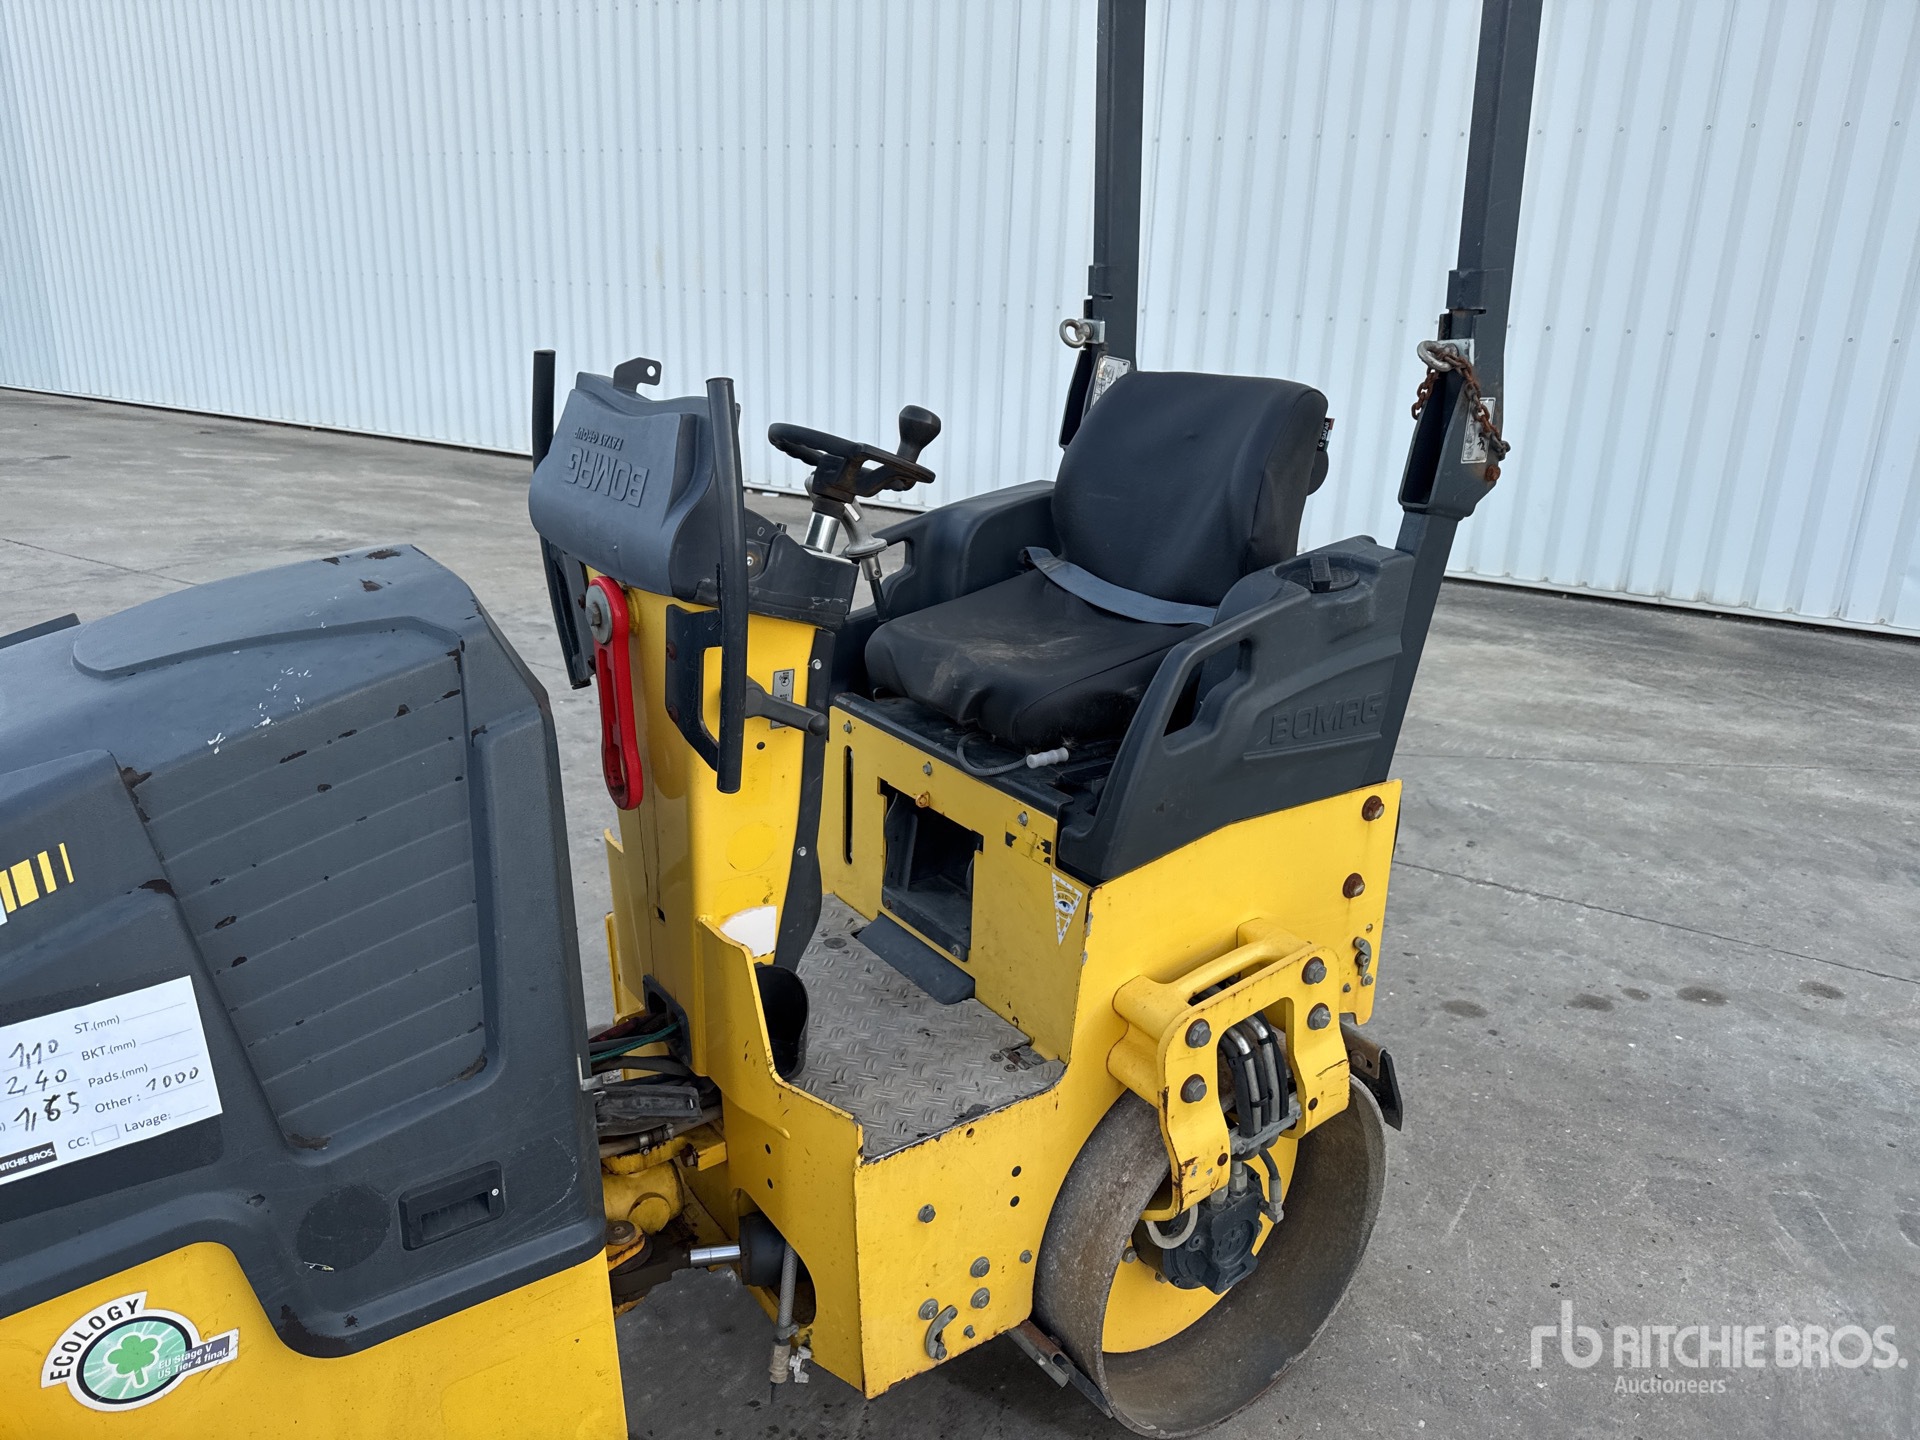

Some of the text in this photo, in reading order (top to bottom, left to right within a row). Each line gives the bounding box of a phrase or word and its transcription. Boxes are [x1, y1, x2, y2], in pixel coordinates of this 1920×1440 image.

[563, 446, 650, 508] BOMAG
[1269, 691, 1384, 745] BOMAG
[74, 1015, 120, 1034] ST.(mm)
[81, 1039, 136, 1061] BKT.(mm)
[88, 1064, 148, 1088] Pads.(mm)
[146, 1066, 200, 1092] 1000
[124, 1112, 172, 1132] Lavage:
[67, 1136, 90, 1150] CC:
[50, 1298, 139, 1380] ECOLOGY
[157, 1347, 229, 1379] US Tier 4 final
[159, 1343, 213, 1369] EU Stage V
